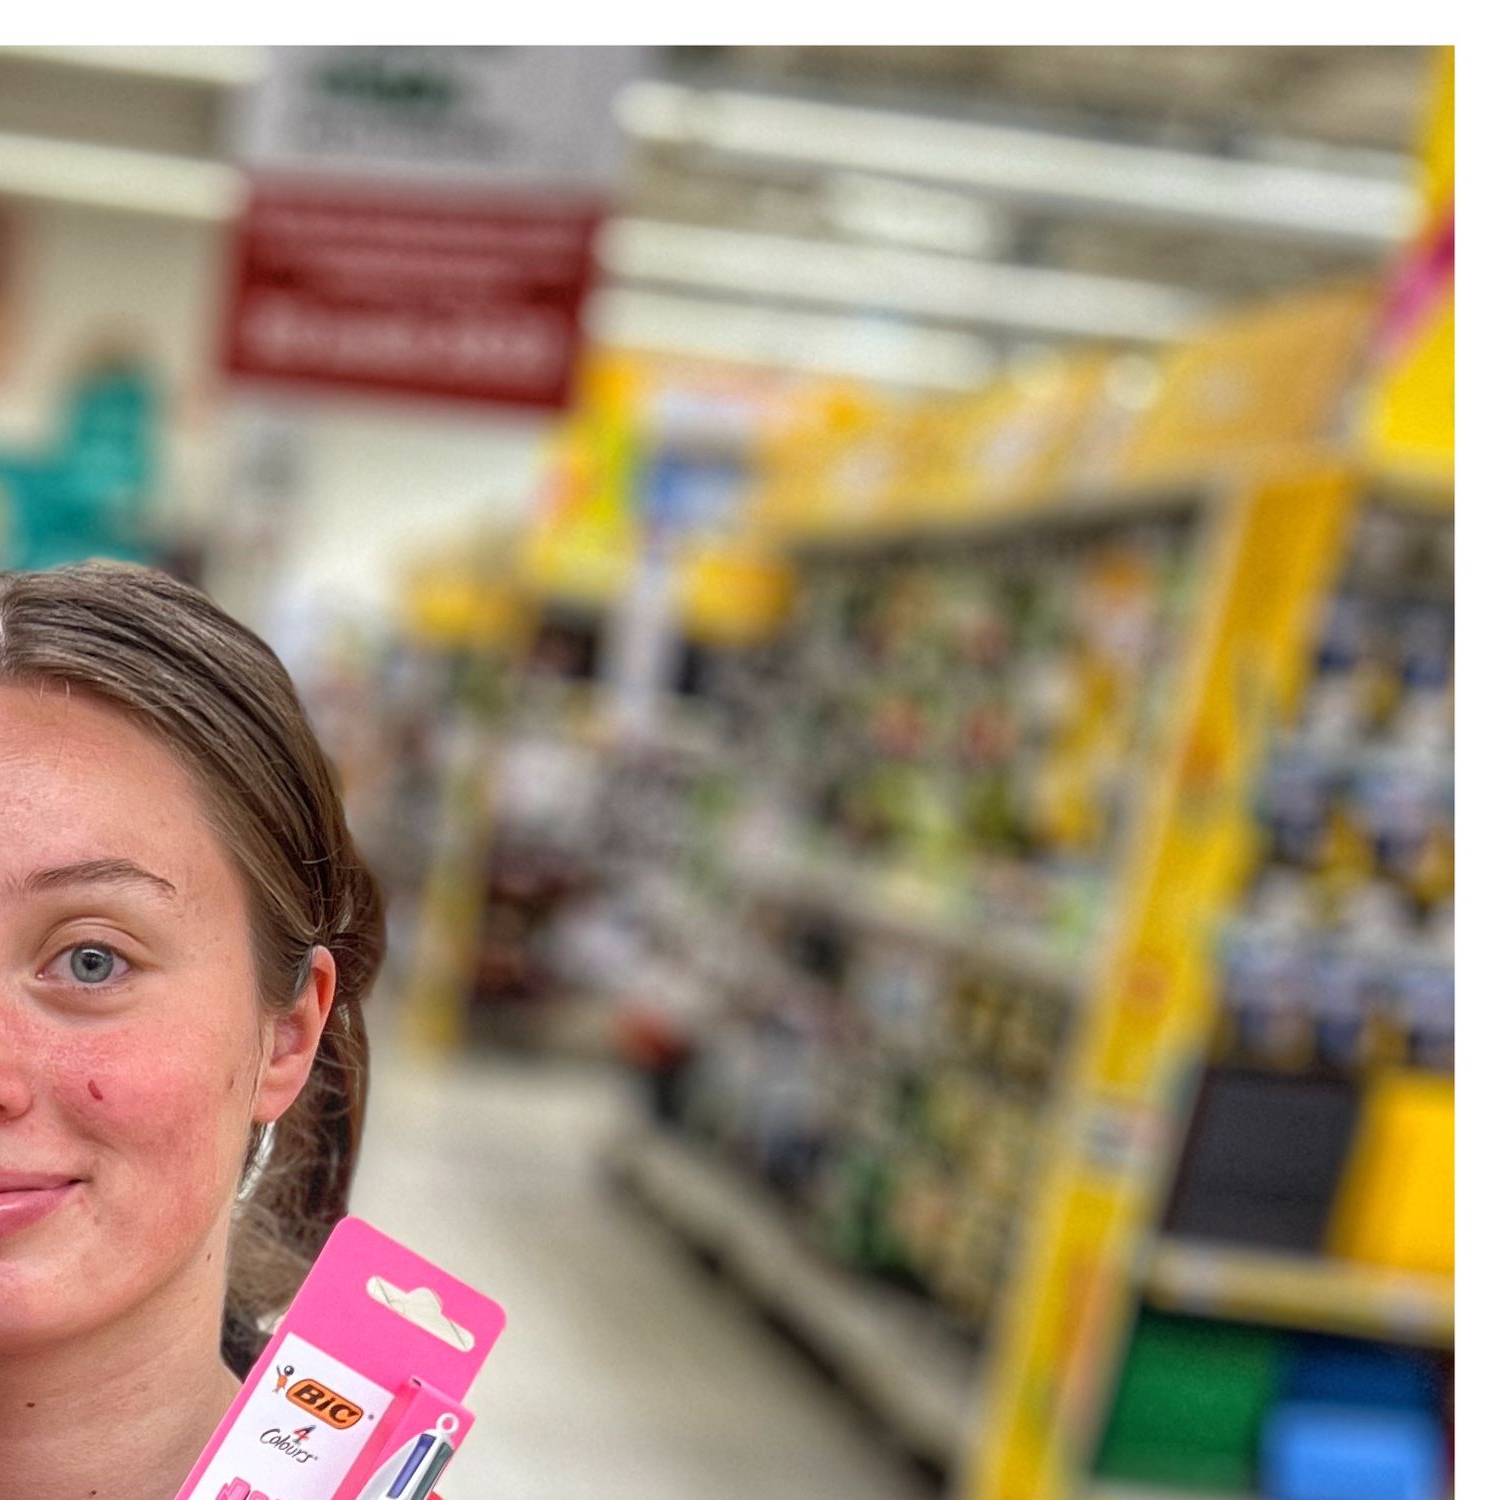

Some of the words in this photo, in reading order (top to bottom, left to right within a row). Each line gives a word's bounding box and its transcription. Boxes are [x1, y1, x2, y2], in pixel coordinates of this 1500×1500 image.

[294, 1383, 357, 1424] BIC
[260, 1428, 315, 1464] Colours
[294, 1424, 316, 1445] 4
